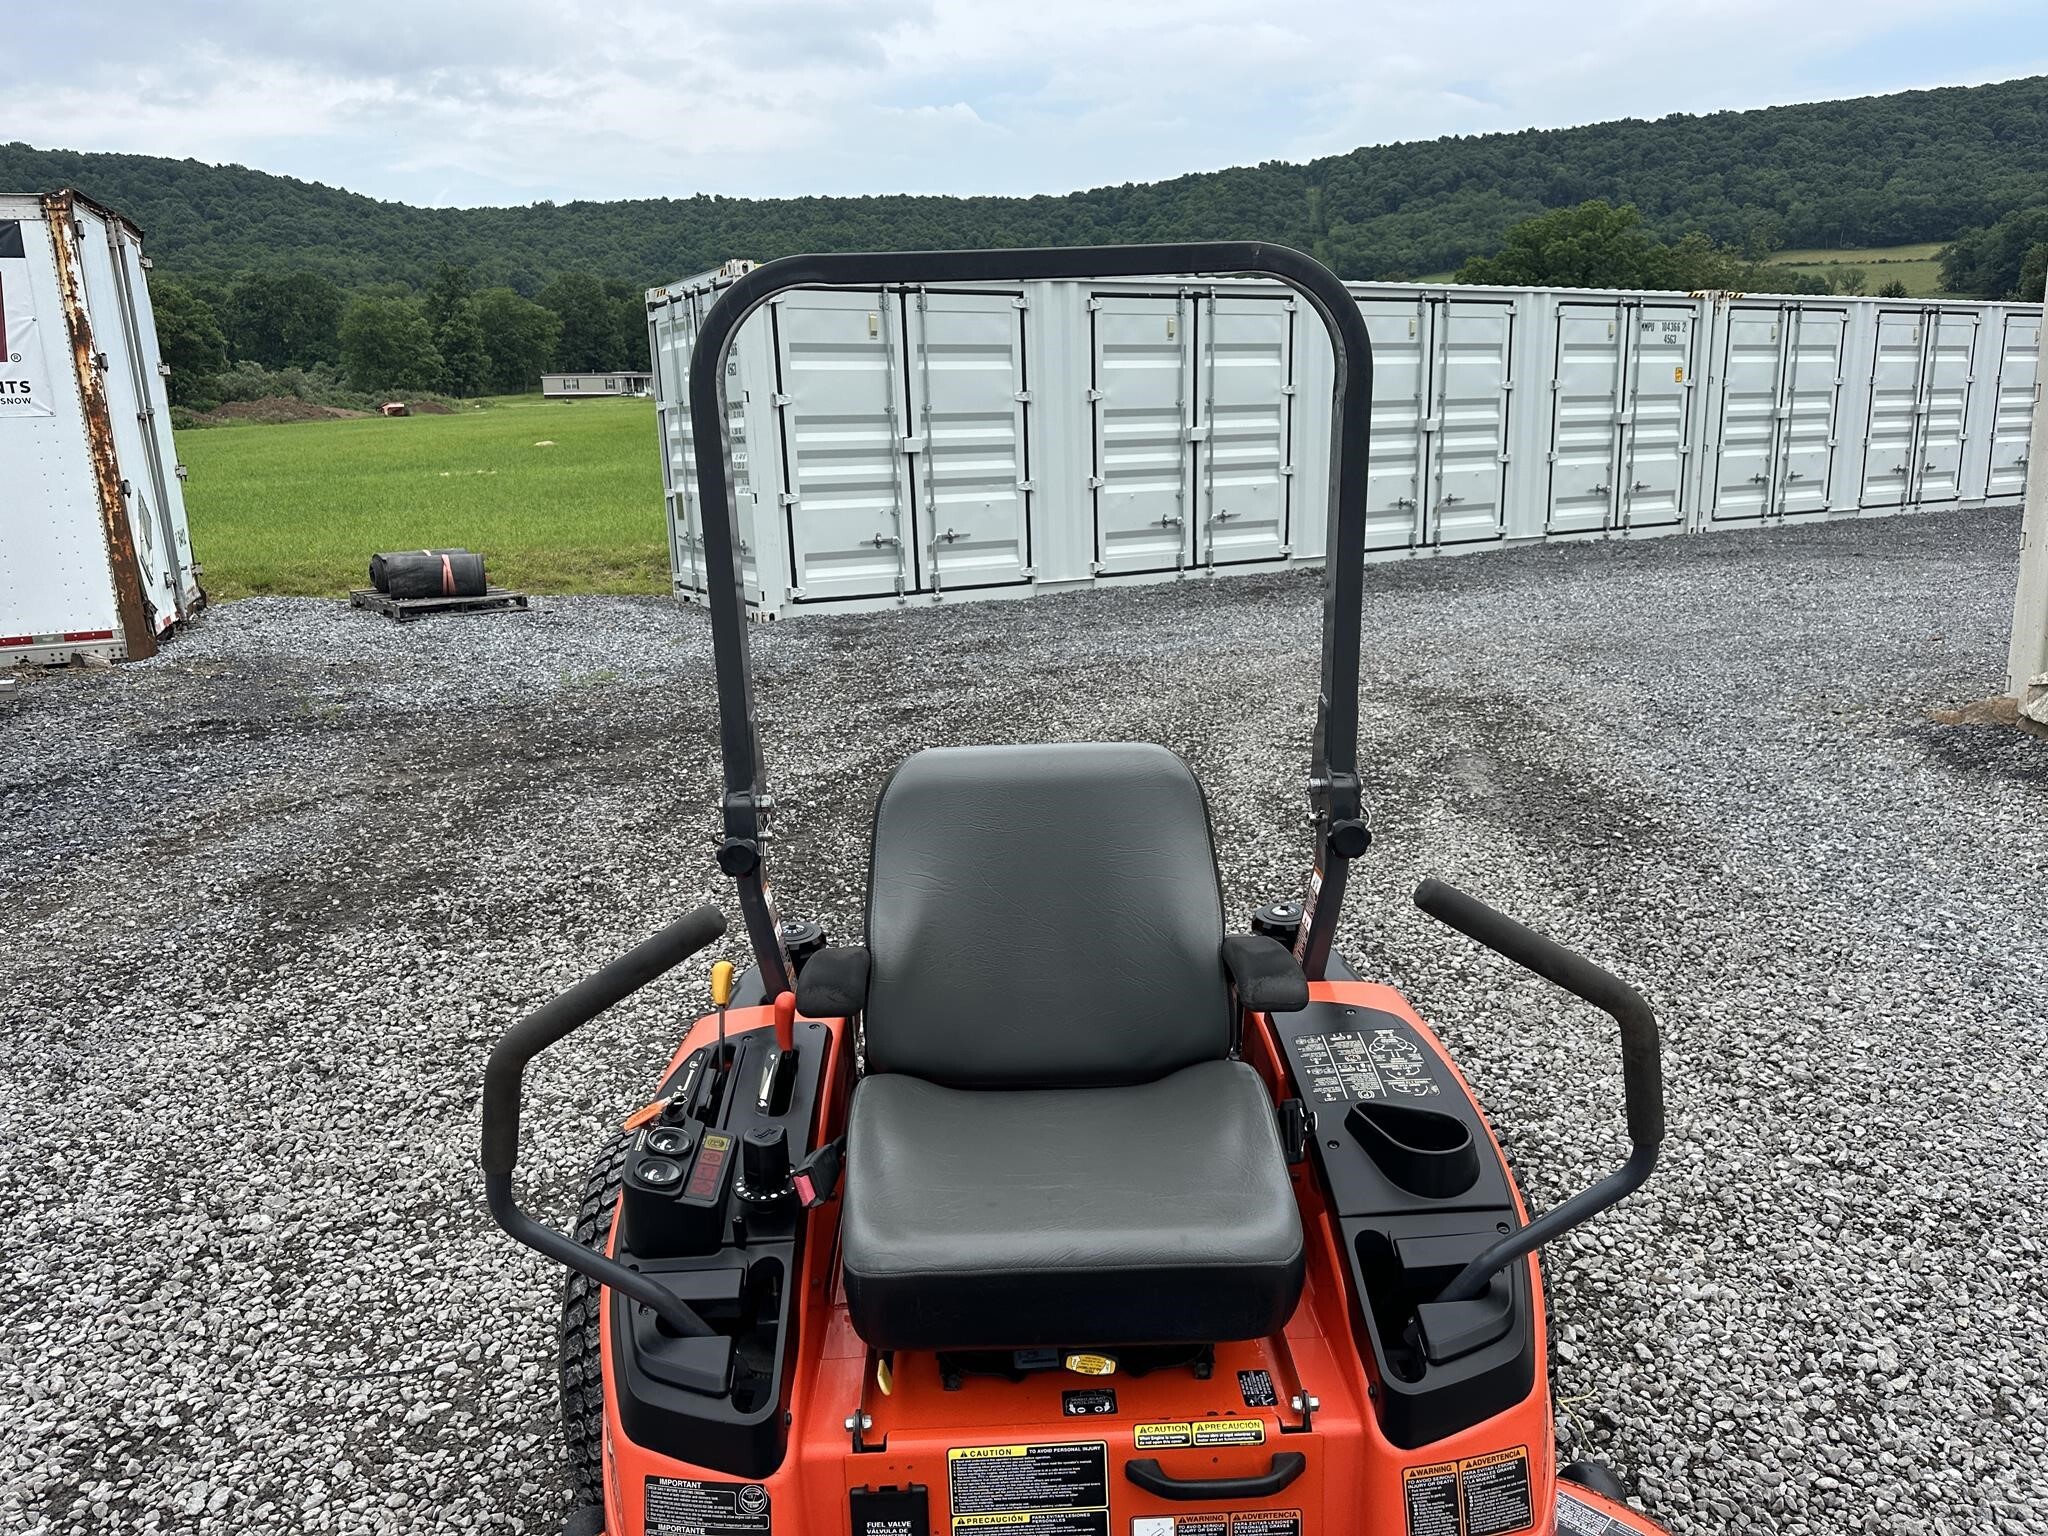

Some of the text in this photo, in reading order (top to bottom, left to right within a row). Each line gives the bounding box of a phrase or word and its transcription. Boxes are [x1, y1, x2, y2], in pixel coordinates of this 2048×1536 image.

[0, 397, 31, 405] SNOW
[1147, 1424, 1188, 1433] CAUTION
[1204, 1421, 1260, 1431] PRECAUCIÓN
[970, 1449, 1012, 1457] CAUTION
[1472, 1450, 1521, 1467] ADVERTENCIA
[1416, 1465, 1452, 1476] WARNING
[659, 1478, 702, 1489] IMPORTANT
[966, 1515, 1024, 1525] PRECAUCIÓN
[1186, 1515, 1224, 1523] WARNING
[1242, 1511, 1298, 1520] ADVERTENCIA
[658, 1523, 706, 1535] IMPORTANTE
